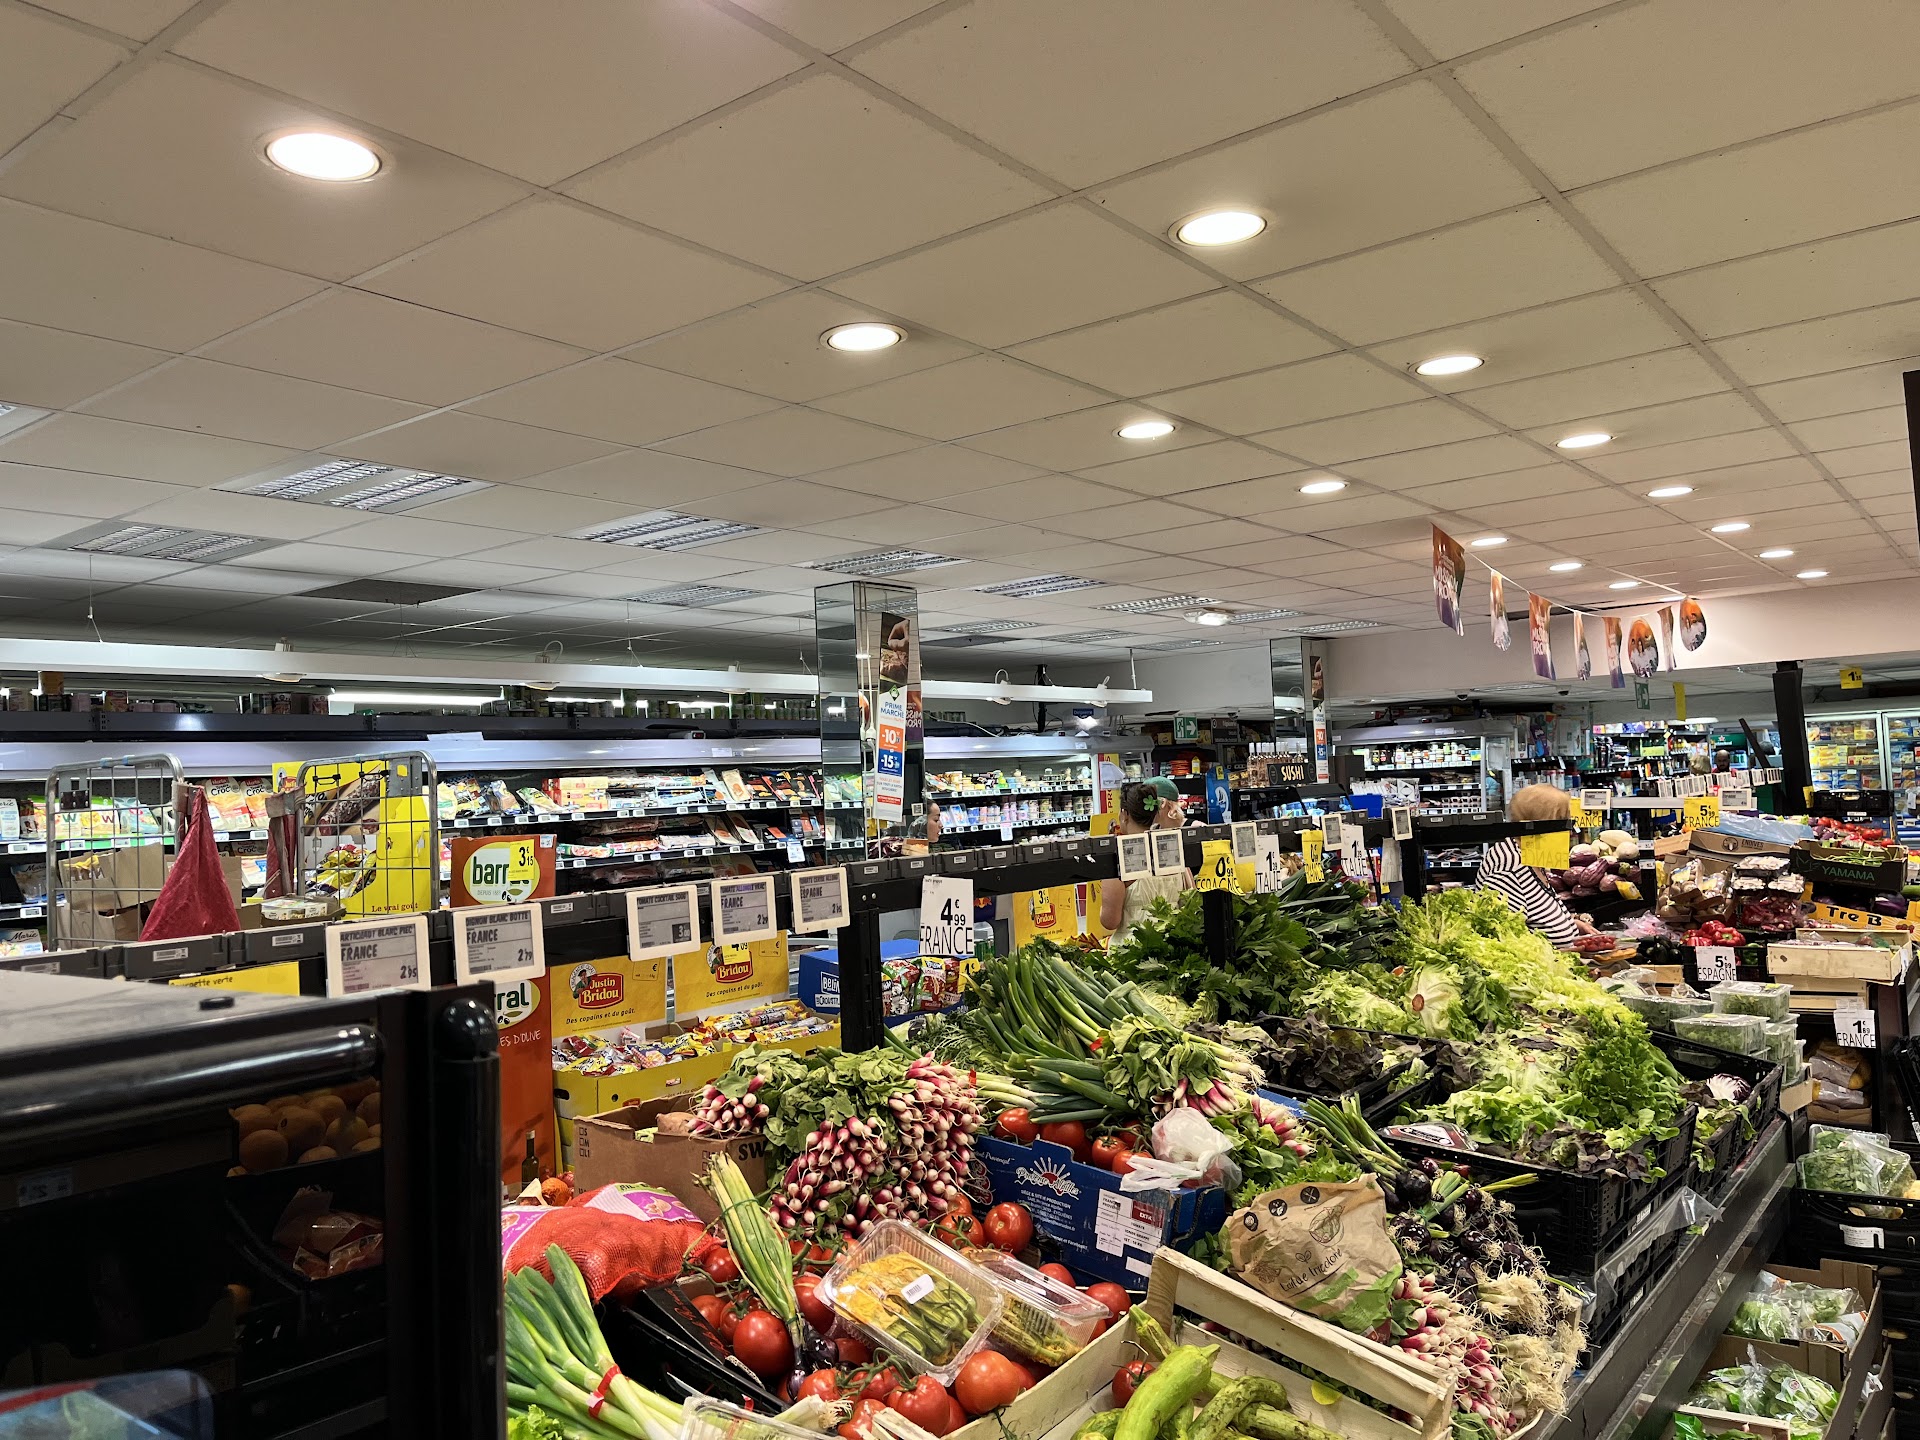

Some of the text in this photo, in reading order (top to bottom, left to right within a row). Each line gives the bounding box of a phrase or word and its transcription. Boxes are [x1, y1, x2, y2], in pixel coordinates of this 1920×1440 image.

[884, 701, 903, 711] PRIME
[1281, 765, 1305, 782] SUSHI
[210, 786, 231, 796] Croc
[246, 788, 265, 797] Croc
[1684, 816, 1720, 828] FRANCE
[518, 846, 534, 867] 3€15
[1822, 866, 1875, 881] YAMAMA
[800, 886, 823, 899] ESPAGNE
[371, 905, 383, 913] Le
[721, 896, 744, 909] FRANCE
[509, 911, 528, 921] BOTTE
[940, 898, 966, 926] 4€99
[1826, 906, 1882, 926] Tre B
[12, 931, 38, 941] Marie
[466, 929, 499, 945] FRANCE
[919, 926, 974, 954] FRANCE
[340, 943, 378, 962] FRANCE
[717, 963, 749, 979] Bridou
[1697, 967, 1737, 981] ESPAGNE
[213, 975, 233, 984] verte
[589, 976, 616, 990] Justin
[496, 982, 530, 1011] ral
[581, 988, 619, 1004] Bridou
[706, 990, 716, 998] Des
[566, 1016, 578, 1025] Des
[579, 1012, 603, 1023] copains
[1836, 1032, 1876, 1048] FRANCE
[1047, 1197, 1071, 1209] PRODUCTION
